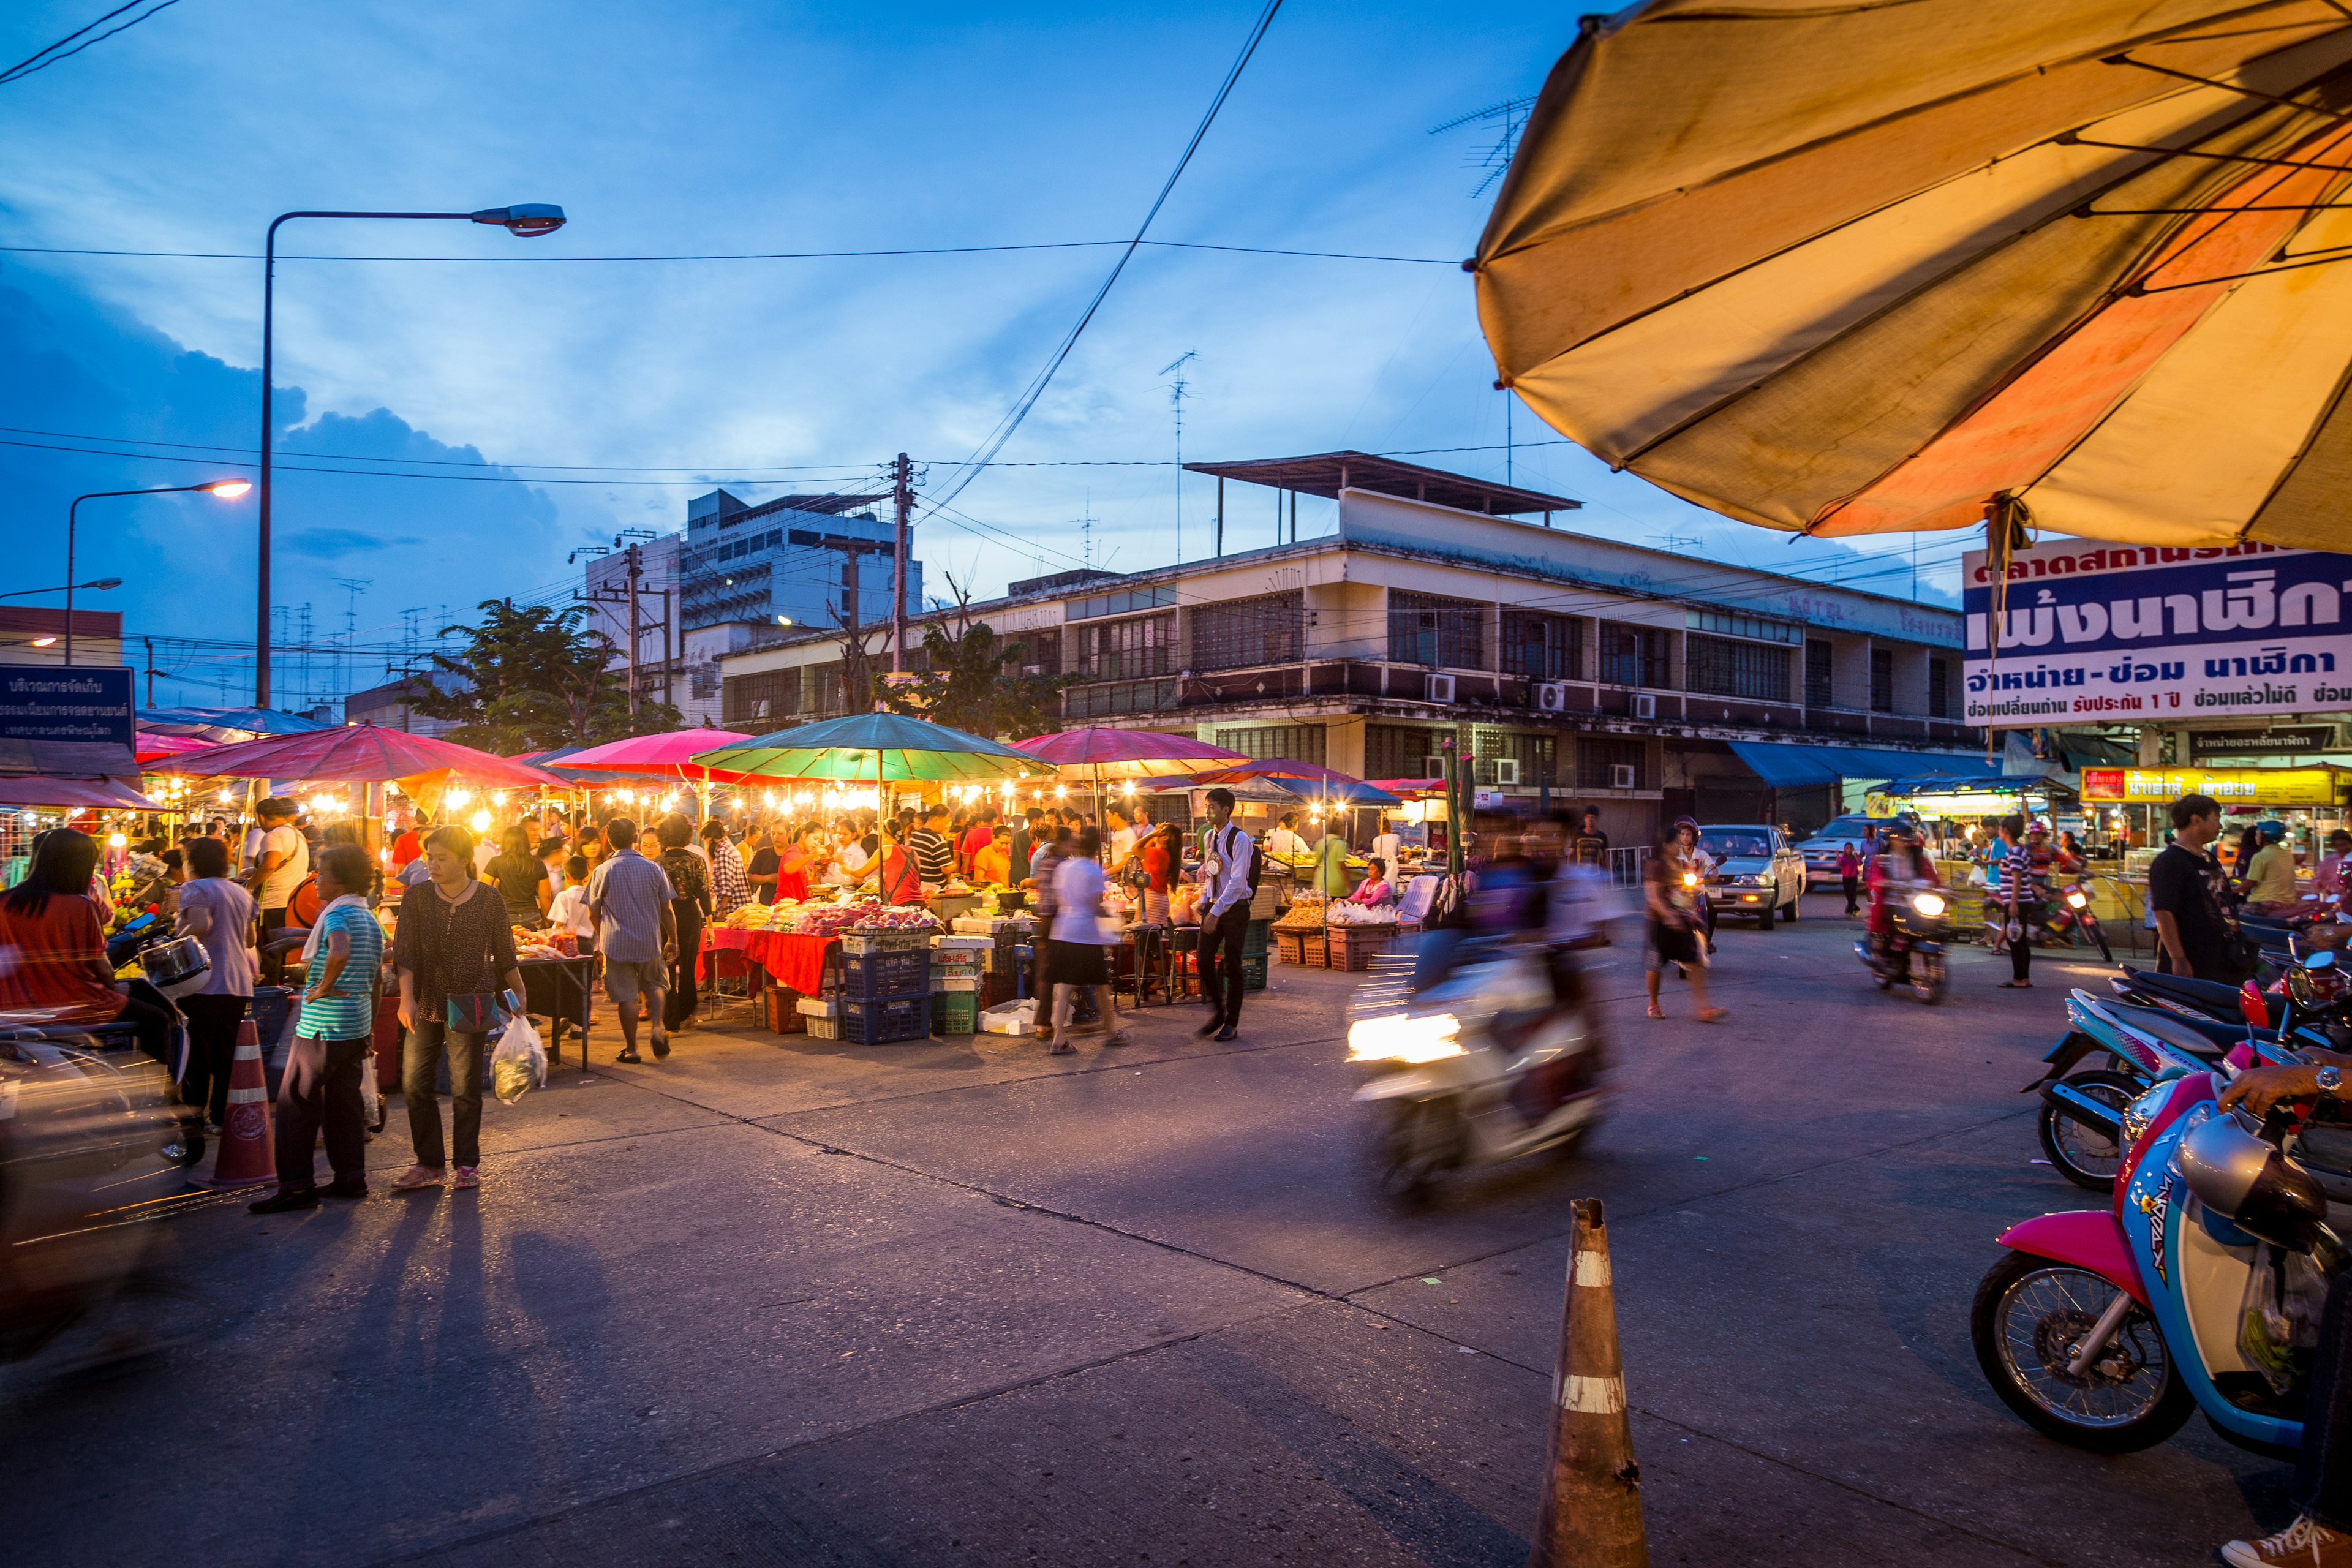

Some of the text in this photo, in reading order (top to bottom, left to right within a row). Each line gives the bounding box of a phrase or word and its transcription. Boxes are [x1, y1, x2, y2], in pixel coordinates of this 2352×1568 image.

[2205, 646, 2334, 677] นาฬิกา
[2073, 693, 2141, 712] รับประกัน
[2152, 694, 2158, 709] 1
[2164, 692, 2180, 707] ปี
[2194, 682, 2296, 706] ซ่อมแล้วไม่ดี
